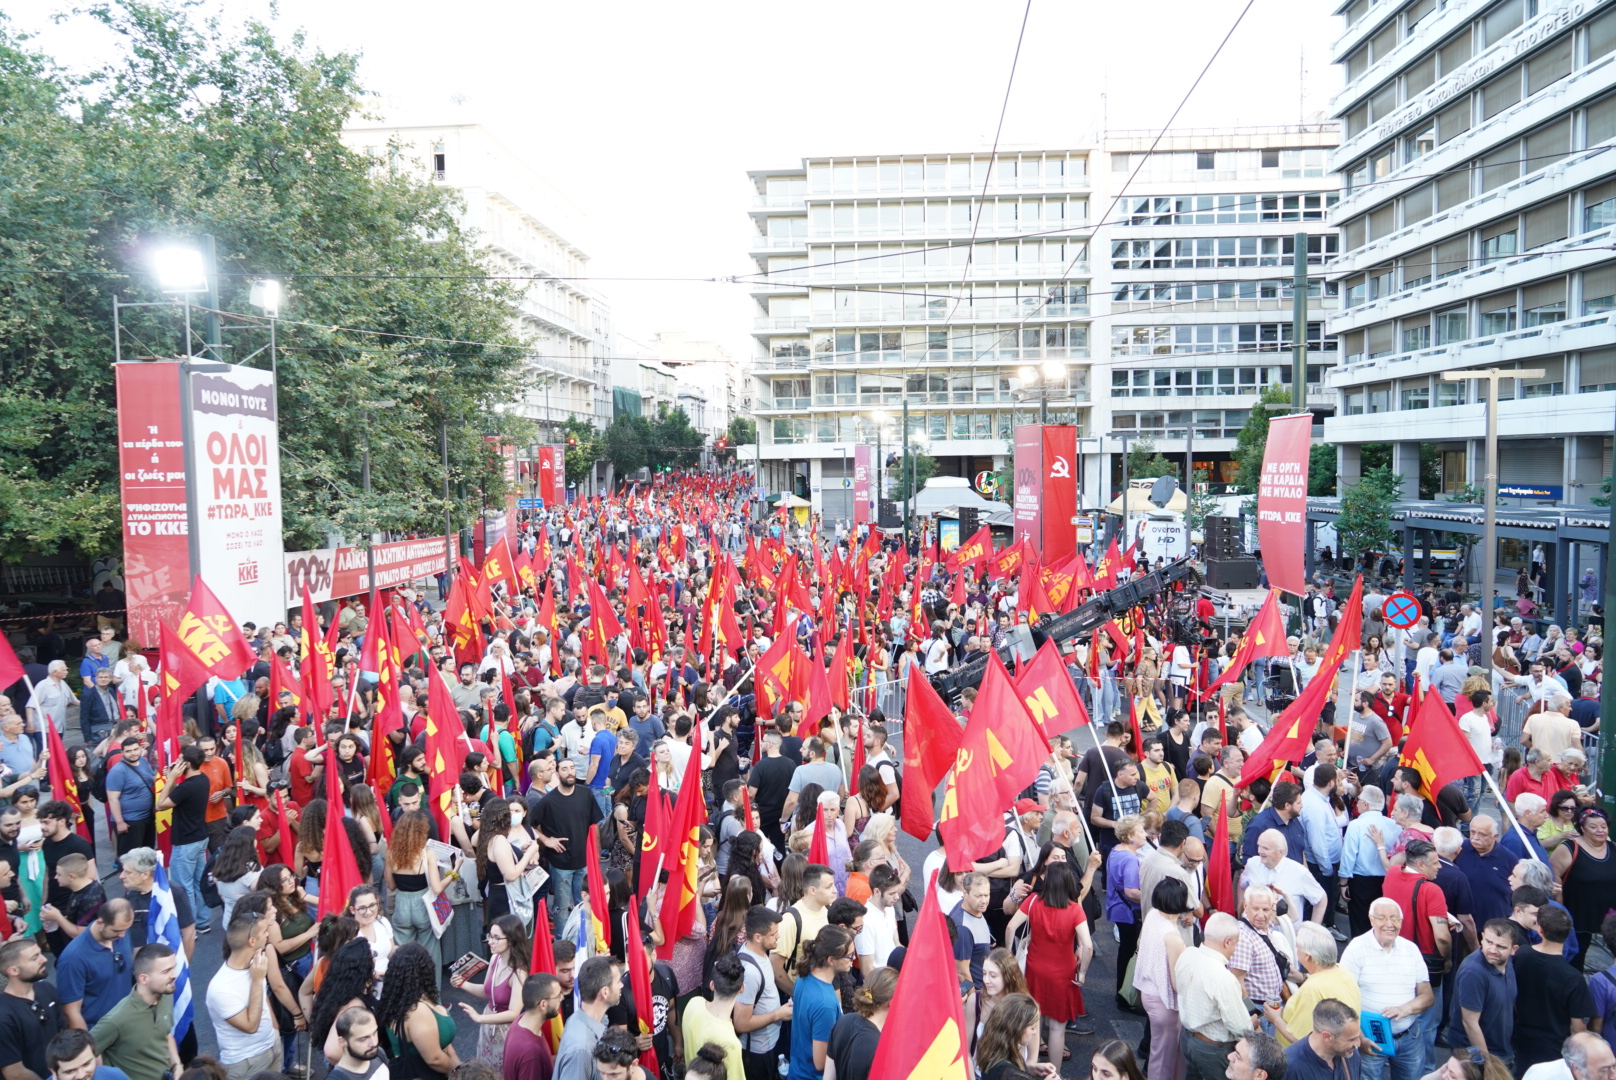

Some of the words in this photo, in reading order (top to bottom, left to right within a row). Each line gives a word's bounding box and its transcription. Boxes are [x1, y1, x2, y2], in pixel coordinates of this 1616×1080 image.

[1512, 3, 1584, 54] ΥΠΟΥΡΓΕΙΟ
[201, 389, 240, 408] ΜΟΝΟΙ
[241, 395, 268, 411] ΤΟΥΣ
[135, 438, 164, 450] κέρδη
[206, 430, 268, 465] ΟΛΟΙ
[124, 472, 135, 480] οι
[137, 469, 165, 482] ζωές
[1267, 462, 1278, 473] ΜΕ
[1279, 462, 1300, 474] ΟΡΓΗ
[212, 467, 268, 500] ΜΑΣ
[1261, 474, 1273, 485] ΜΕ
[1274, 474, 1304, 486] ΚΑΡΔΙΑ
[1261, 486, 1272, 497] ΜΕ
[1274, 486, 1303, 499] ΜΥΑΛΟ
[126, 503, 187, 512] ΨΗΦΙΖΟΥΜΕ
[207, 502, 273, 521] #ΤΩΡΑ_ΚΚΕ
[127, 521, 152, 536] ΤΟ
[154, 521, 189, 535] ΚΚΕ
[1151, 526, 1181, 534] overon
[1157, 536, 1176, 544] HD
[373, 545, 406, 566] ΑΧΗΤΙΚΗ
[238, 564, 258, 582] ΚΚΕ
[288, 555, 331, 600] 100%
[177, 611, 232, 668] ΚΚΕ
